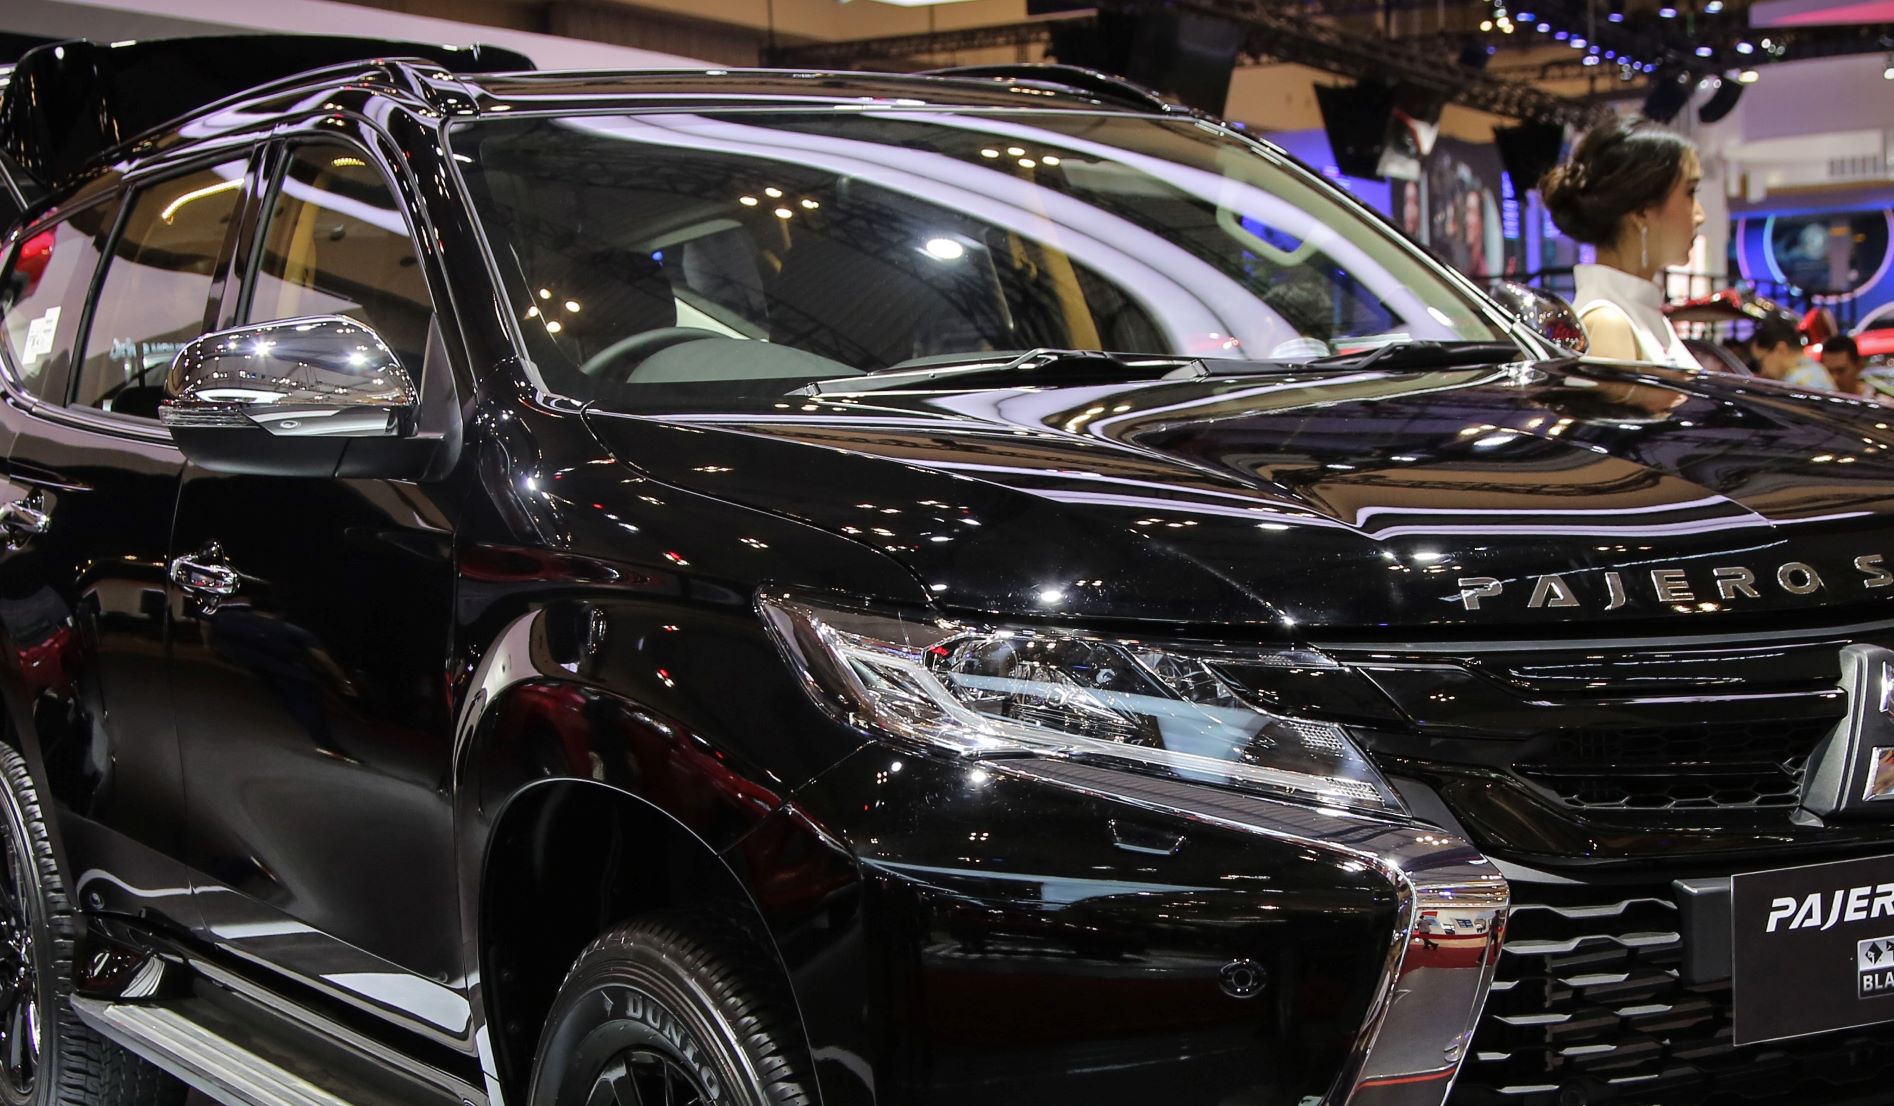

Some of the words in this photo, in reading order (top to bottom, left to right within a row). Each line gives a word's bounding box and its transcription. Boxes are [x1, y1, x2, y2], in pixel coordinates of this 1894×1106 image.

[1458, 561, 1826, 611] PAJERO
[1765, 882, 1894, 933] PAJER
[1862, 970, 1894, 992] BLA
[625, 991, 728, 1106] DUNLO
